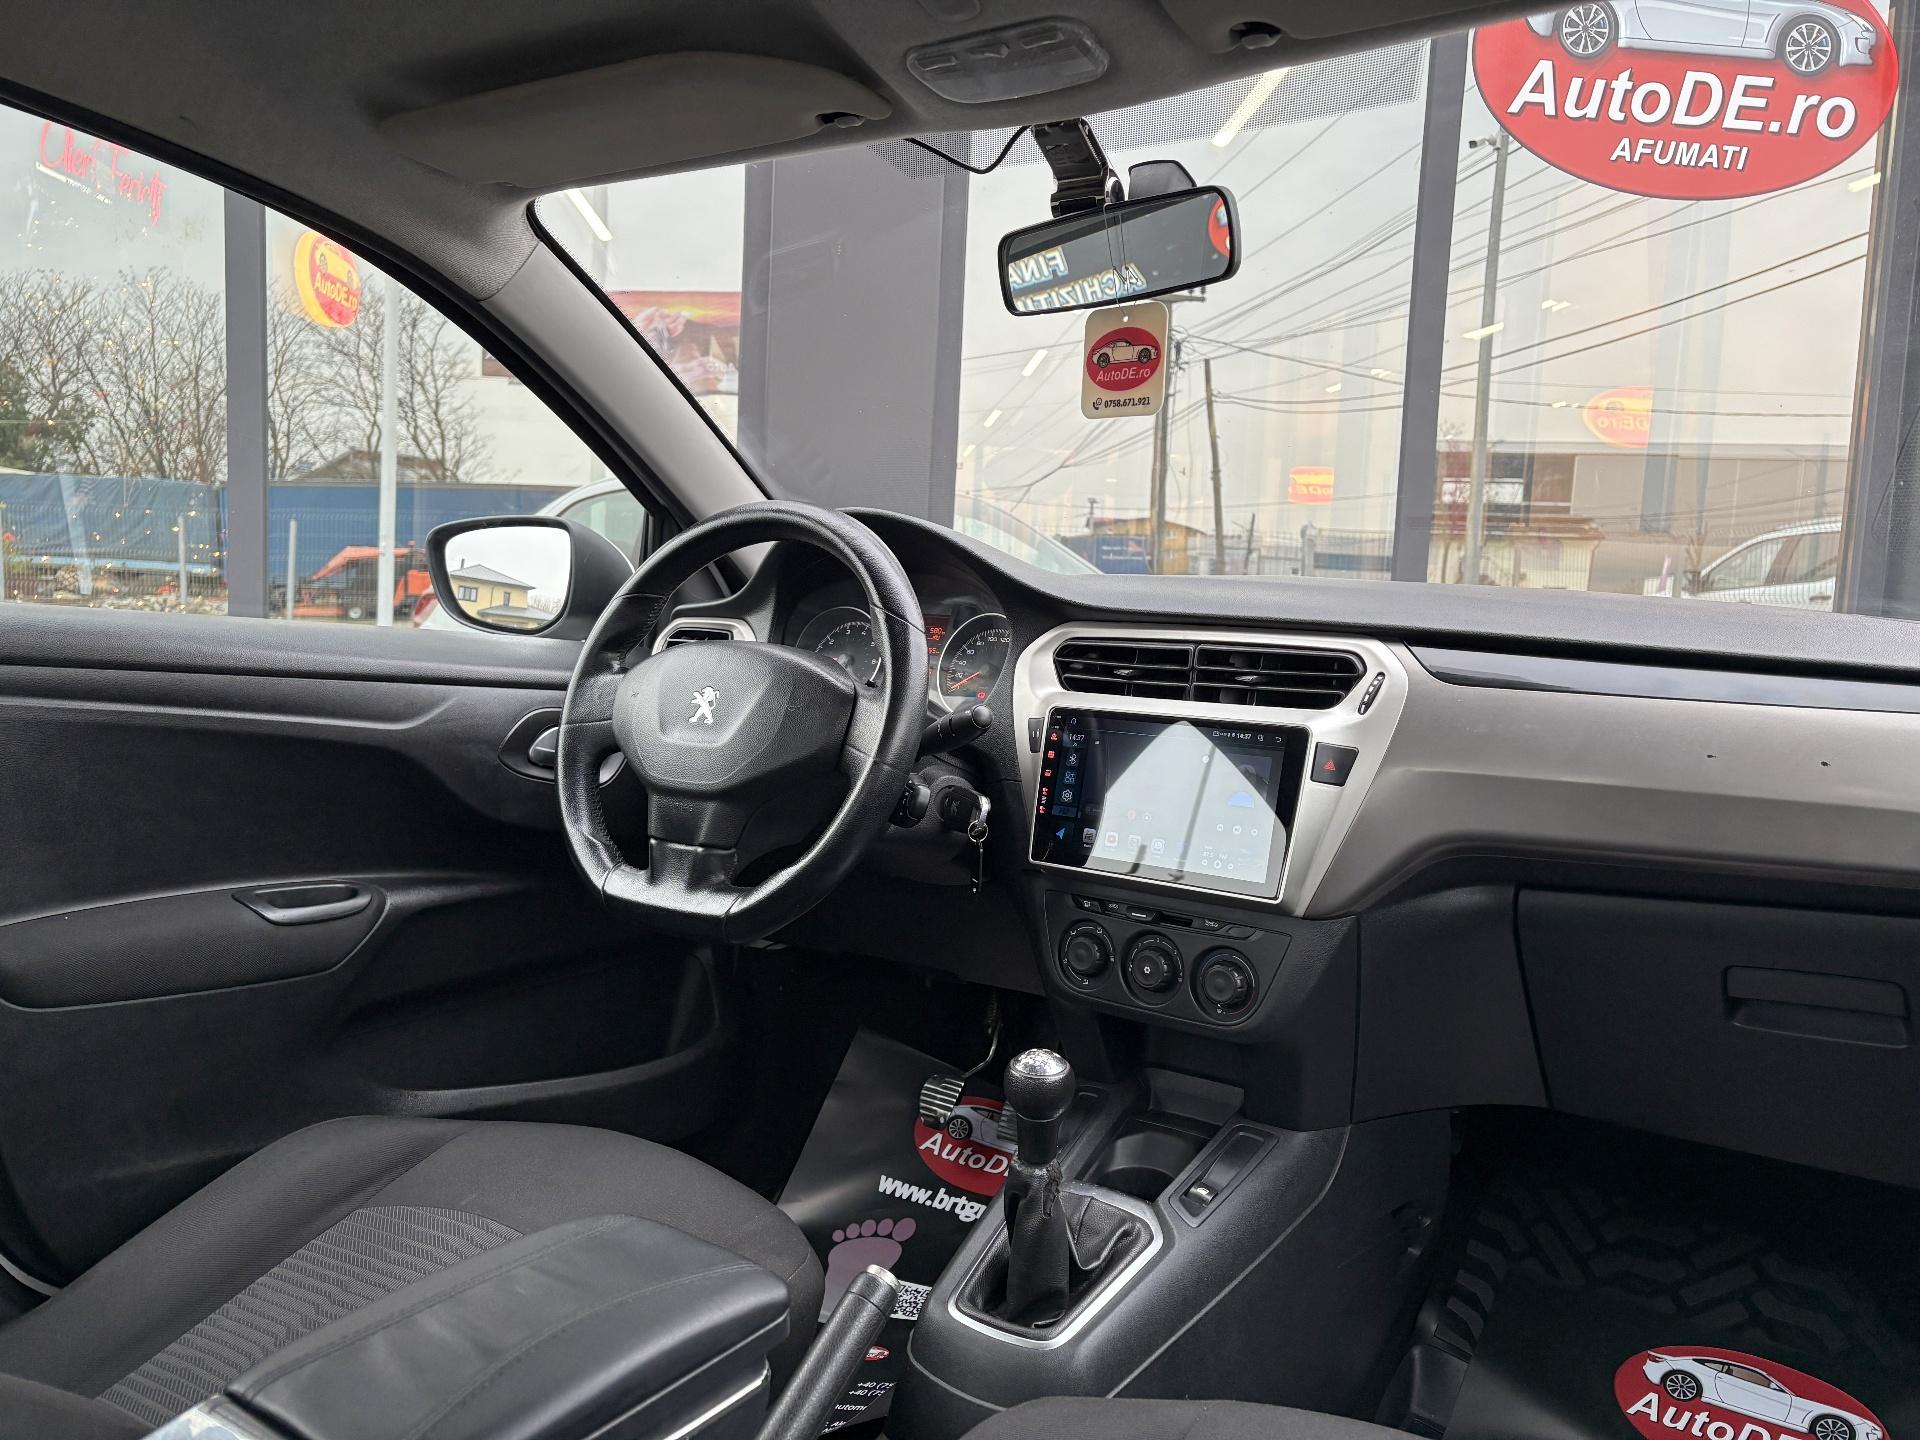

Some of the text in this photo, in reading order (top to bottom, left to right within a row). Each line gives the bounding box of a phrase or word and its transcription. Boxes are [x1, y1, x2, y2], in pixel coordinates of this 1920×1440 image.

[1507, 59, 1857, 140] AutoDE.ro
[1611, 137, 1749, 171] AFUMATI
[313, 271, 359, 310] AutoDE.ro
[1096, 366, 1151, 382] AutoDE.ro
[1104, 396, 1151, 409] 0758.671.921
[1069, 733, 1085, 742] 14:37
[1236, 732, 1252, 740] 14:37
[919, 1132, 1009, 1177] AutoD
[1627, 1392, 1801, 1440] AutoD
